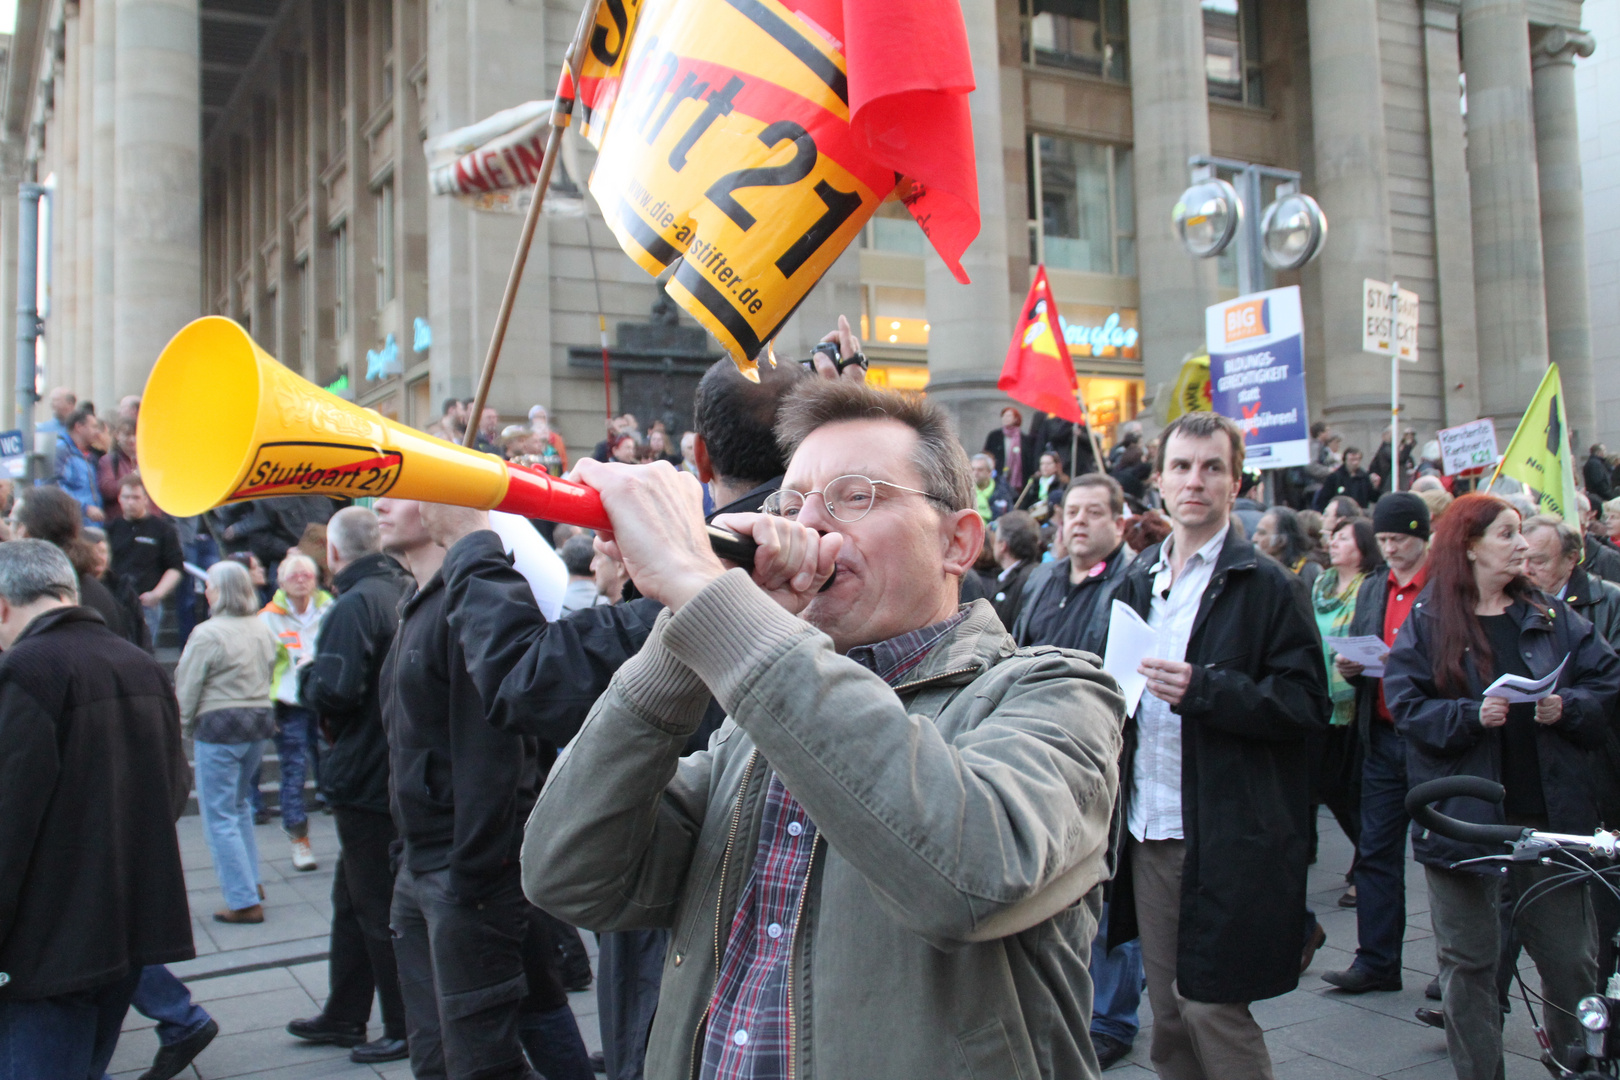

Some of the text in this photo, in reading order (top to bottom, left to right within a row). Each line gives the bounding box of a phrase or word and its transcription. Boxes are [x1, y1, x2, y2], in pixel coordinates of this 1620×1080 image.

[456, 136, 547, 194] NEIN
[704, 121, 863, 279] 21
[1227, 307, 1256, 332] BIG
[0, 435, 20, 454] WC
[1471, 448, 1491, 465] K21
[249, 461, 392, 491] Stuttgart 21
